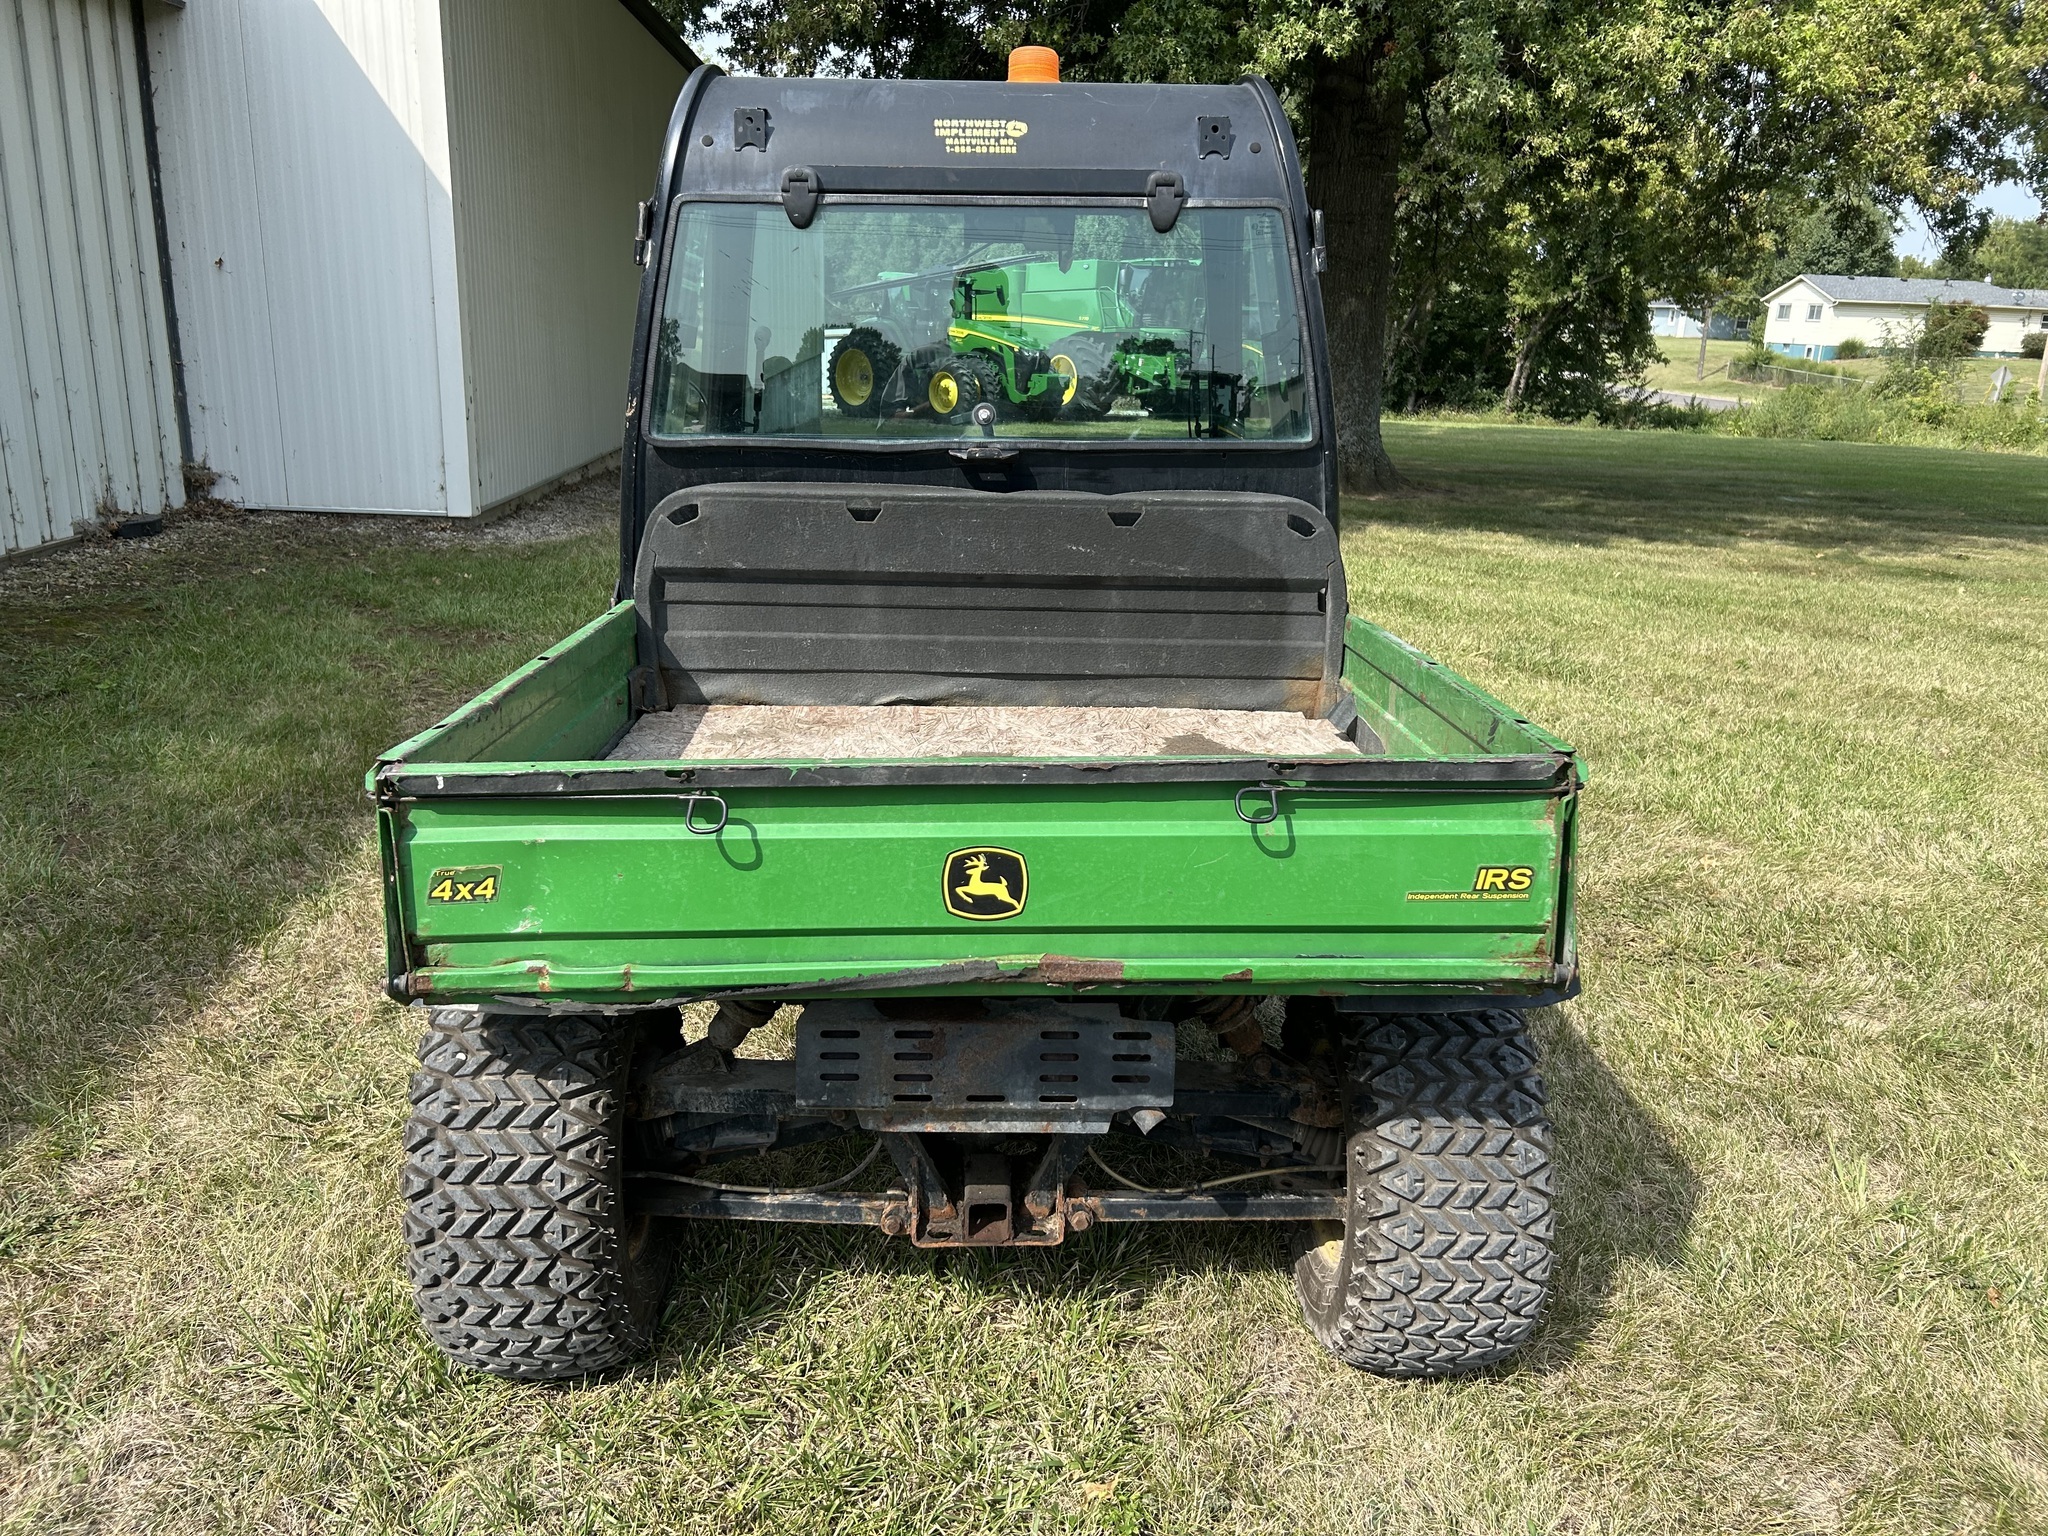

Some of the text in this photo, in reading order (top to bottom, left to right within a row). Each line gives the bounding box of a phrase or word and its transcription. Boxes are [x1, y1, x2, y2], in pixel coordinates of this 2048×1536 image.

[934, 119, 1007, 128] NORTHWEST
[935, 128, 1006, 137] IMPLEMENT
[1000, 138, 1017, 146] MO.
[989, 146, 1017, 154] DEERE
[1474, 867, 1534, 891] IRS
[430, 876, 497, 901] 4x4
[1407, 892, 1529, 901] Independent Rear Suspension
